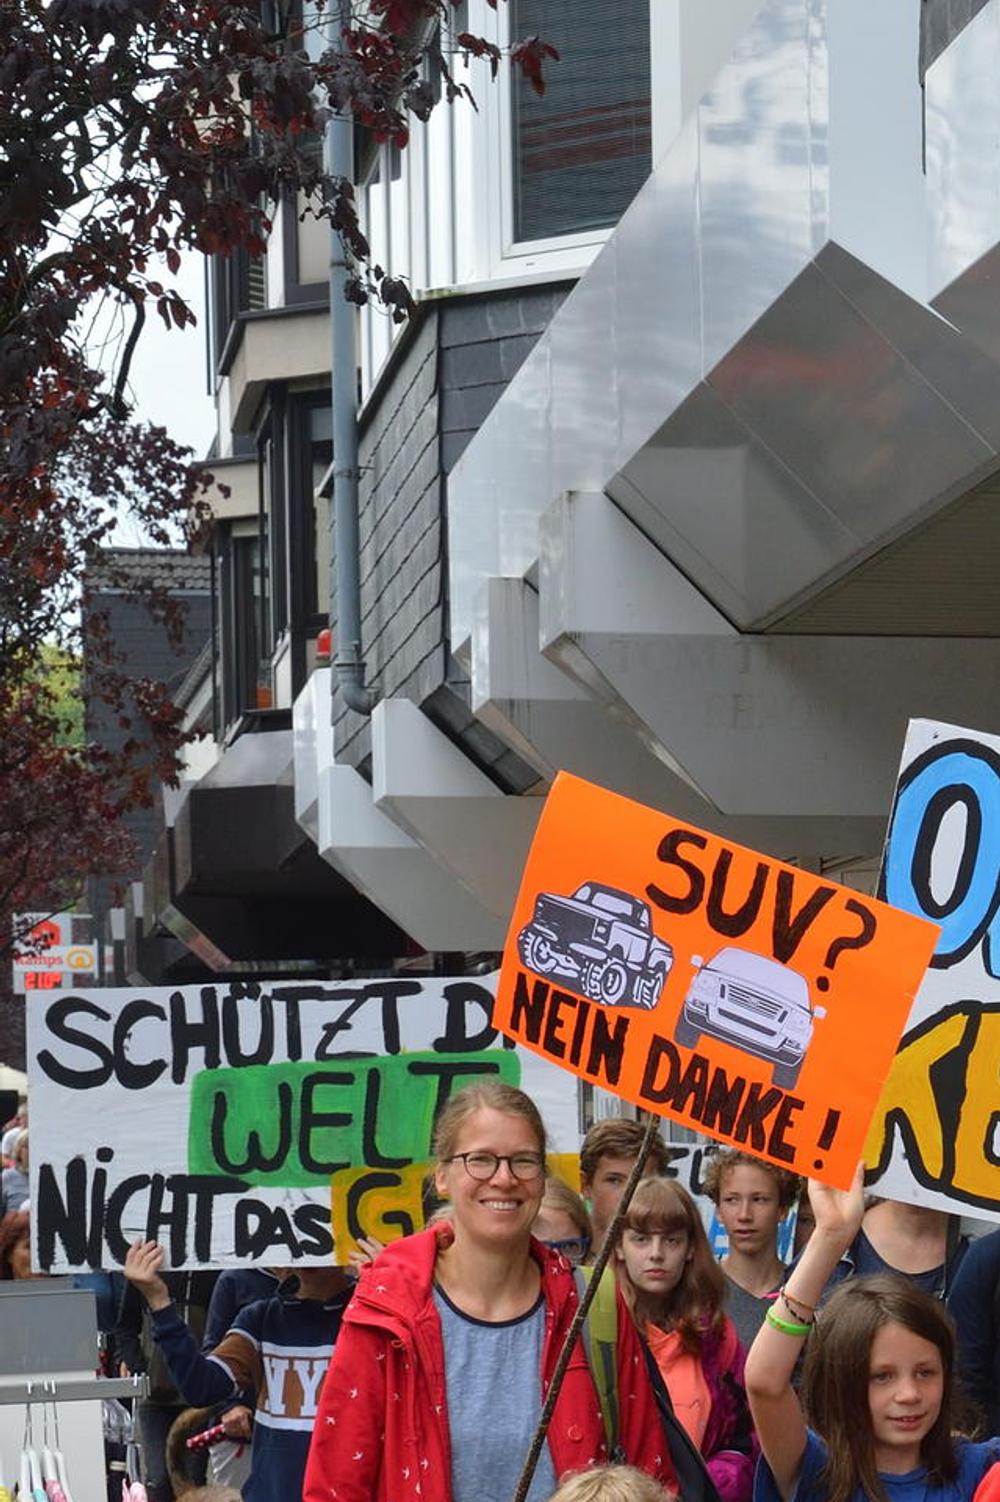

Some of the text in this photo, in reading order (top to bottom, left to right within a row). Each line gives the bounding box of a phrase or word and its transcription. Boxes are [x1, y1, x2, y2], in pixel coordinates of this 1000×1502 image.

[644, 829, 877, 993] SUV?
[36, 981, 517, 1089] SCHÜTZT D
[510, 973, 630, 1086] NEIN
[210, 1061, 500, 1175] WELT
[234, 1199, 335, 1259] DAS
[346, 1172, 441, 1247] G
